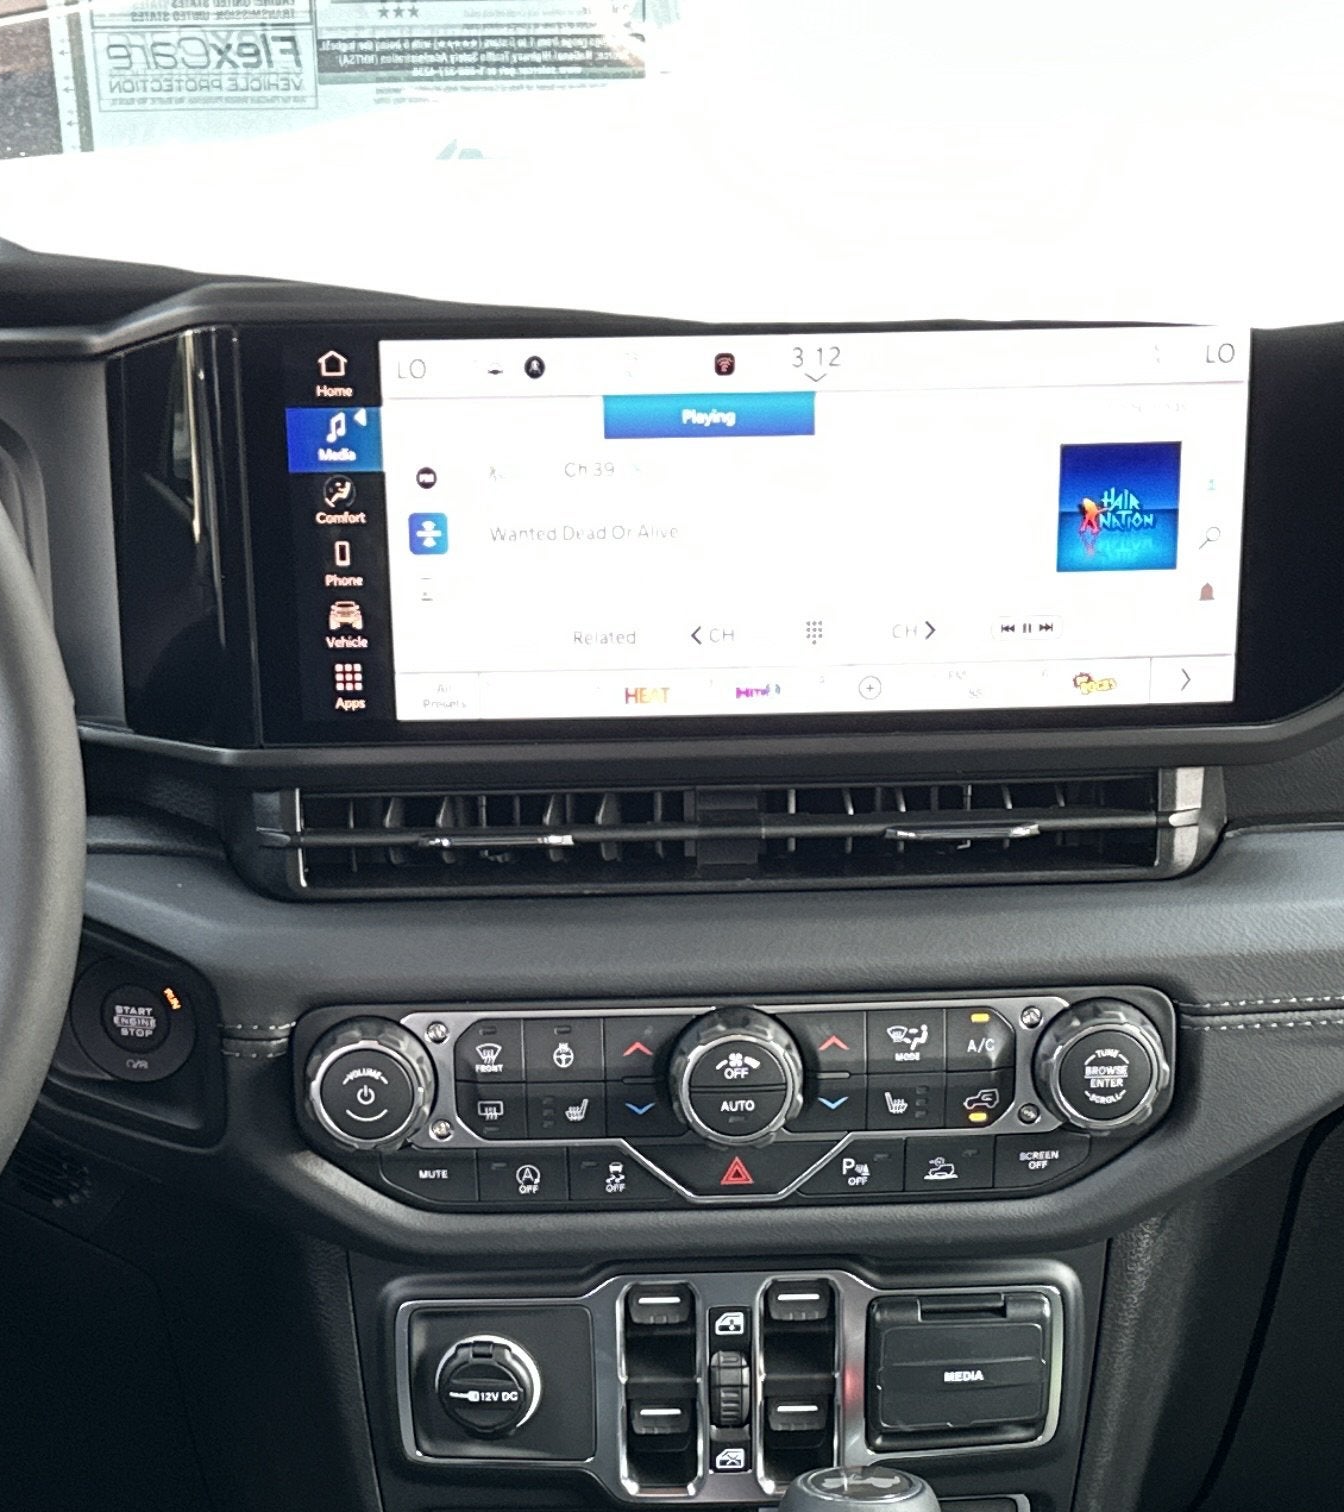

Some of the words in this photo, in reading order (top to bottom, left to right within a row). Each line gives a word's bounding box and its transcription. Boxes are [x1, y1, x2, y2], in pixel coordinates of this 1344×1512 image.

[791, 346, 842, 368] 312
[1205, 342, 1235, 364] LO
[396, 358, 426, 379] LO
[316, 384, 353, 398] Home
[681, 408, 737, 427] Playing
[318, 448, 356, 462] Media
[1100, 487, 1141, 511] HAIR
[315, 510, 366, 525] Comfort
[1099, 510, 1154, 529] NATION
[489, 525, 558, 542] Wanted
[562, 525, 606, 542] Dead
[612, 525, 633, 540] Or
[637, 525, 680, 541] Alive
[325, 573, 364, 588] Phone
[573, 630, 638, 646] Related
[709, 627, 735, 644] CH
[892, 624, 918, 640] CH
[326, 635, 368, 650] Vehicle
[625, 687, 670, 704] HET
[335, 697, 366, 712] Apps
[115, 1005, 153, 1016] START
[113, 1016, 156, 1028] ENGINE
[120, 1027, 153, 1038] STOP
[967, 1038, 995, 1054] A/C
[896, 1053, 920, 1062] MODE
[1095, 1048, 1120, 1058] TUNE
[347, 1068, 385, 1081] VOLUME
[475, 1063, 503, 1073] FRONT
[724, 1067, 750, 1080] OFF
[1085, 1065, 1128, 1075] BROWSE
[1090, 1078, 1123, 1088] ENTER
[1089, 1092, 1122, 1104] SCROLL
[720, 1100, 755, 1112] AUTO
[1019, 1151, 1060, 1162] SCREEN
[1028, 1160, 1048, 1170] OFF
[419, 1169, 448, 1180] MUTE
[606, 1183, 626, 1193] OFF
[848, 1176, 868, 1187] OFF
[519, 1184, 538, 1194] OFF
[944, 1370, 984, 1382] MEDIA
[480, 1391, 501, 1401] 12V
[503, 1391, 518, 1401] DC
